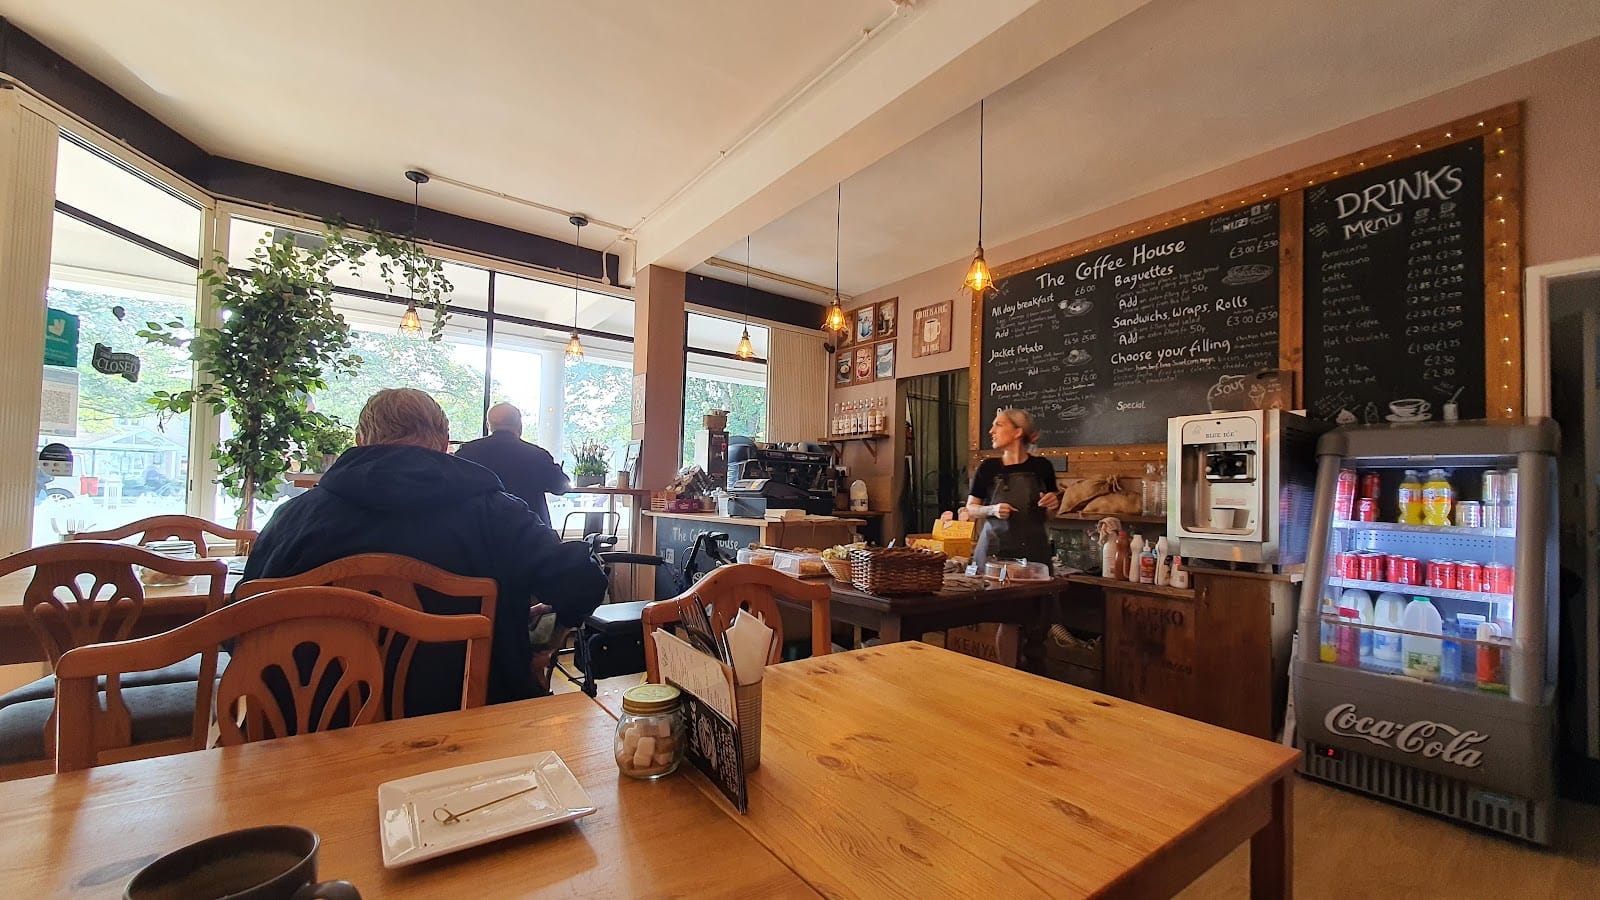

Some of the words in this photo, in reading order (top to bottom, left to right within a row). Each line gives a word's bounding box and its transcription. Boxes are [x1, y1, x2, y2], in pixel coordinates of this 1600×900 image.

[1332, 164, 1464, 220] DRINKS
[1342, 211, 1402, 240] Menu
[1036, 272, 1065, 289] The
[1075, 253, 1126, 281] Coffee
[1132, 240, 1186, 267] House
[1114, 265, 1175, 290] Baguettes
[991, 306, 1002, 318] All
[1002, 304, 1016, 317] day
[1016, 293, 1054, 310] breakfast
[1118, 295, 1138, 310] Add
[1215, 295, 1248, 312] Rolls
[995, 328, 1009, 339] Add
[1119, 331, 1138, 345] Add
[1323, 336, 1340, 348] Hot
[988, 347, 1015, 363] Jacket
[1017, 342, 1044, 354] Potato
[1111, 350, 1152, 365] Choose
[1157, 346, 1187, 363] your
[1189, 338, 1231, 357] filling
[97, 357, 137, 374] CLOSED
[990, 380, 1024, 396] Paninis
[1116, 400, 1147, 412] Special
[672, 526, 687, 543] The
[952, 636, 998, 660] KENYA
